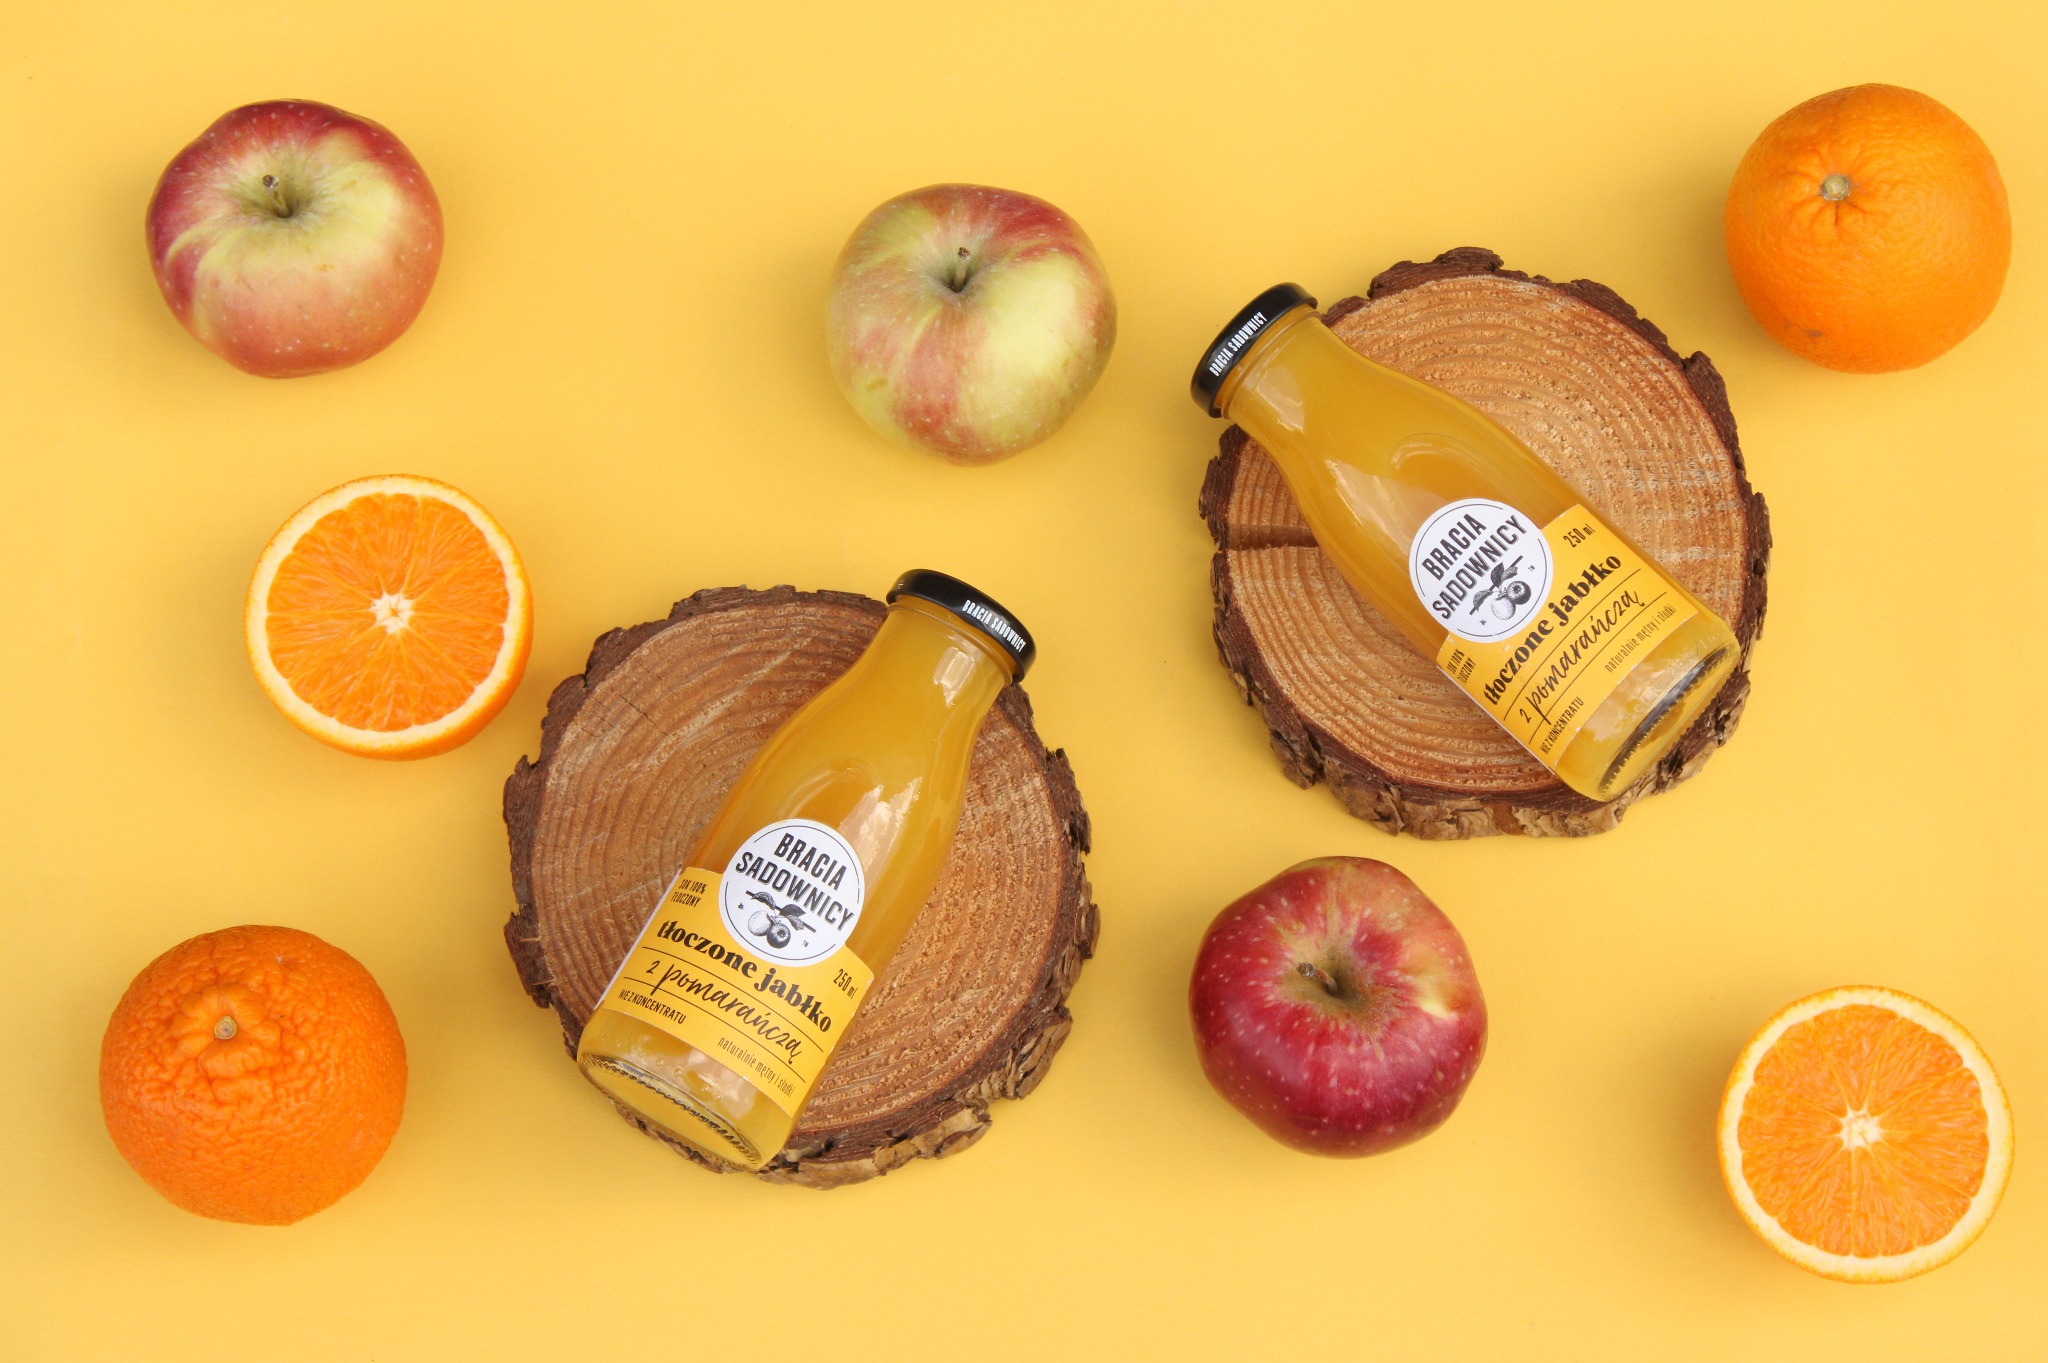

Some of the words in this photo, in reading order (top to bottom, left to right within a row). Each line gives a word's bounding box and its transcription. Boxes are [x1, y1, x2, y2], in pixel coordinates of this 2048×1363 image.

[1209, 348, 1234, 377] BRACIA
[1228, 311, 1267, 352] SADOWNICY
[1422, 513, 1487, 581] BRACIA
[1563, 528, 1586, 548] 250
[1582, 523, 1596, 535] ml
[1432, 514, 1528, 620] SADOWNICY
[961, 599, 993, 625] BRACIA
[991, 617, 1027, 653] SADOWNICY
[1483, 618, 1555, 706] tłoczone
[1548, 555, 1622, 628] jabłko
[1605, 639, 1639, 673] naturalnie
[1636, 621, 1659, 642] mętny
[1526, 590, 1645, 725] pomarańczą
[1547, 696, 1584, 743] KONCENTRATU
[735, 851, 855, 932] SADOWNICY
[773, 832, 847, 891] BRACIA
[657, 919, 758, 979] tłoczone
[753, 968, 832, 1033] jabłko
[833, 968, 853, 992] 250
[847, 986, 859, 1000] ml
[631, 993, 687, 1025] KONCENTRATU
[649, 963, 802, 1065] pomarańczą
[717, 1037, 757, 1068] naturalnie
[755, 1061, 777, 1084] mętny
